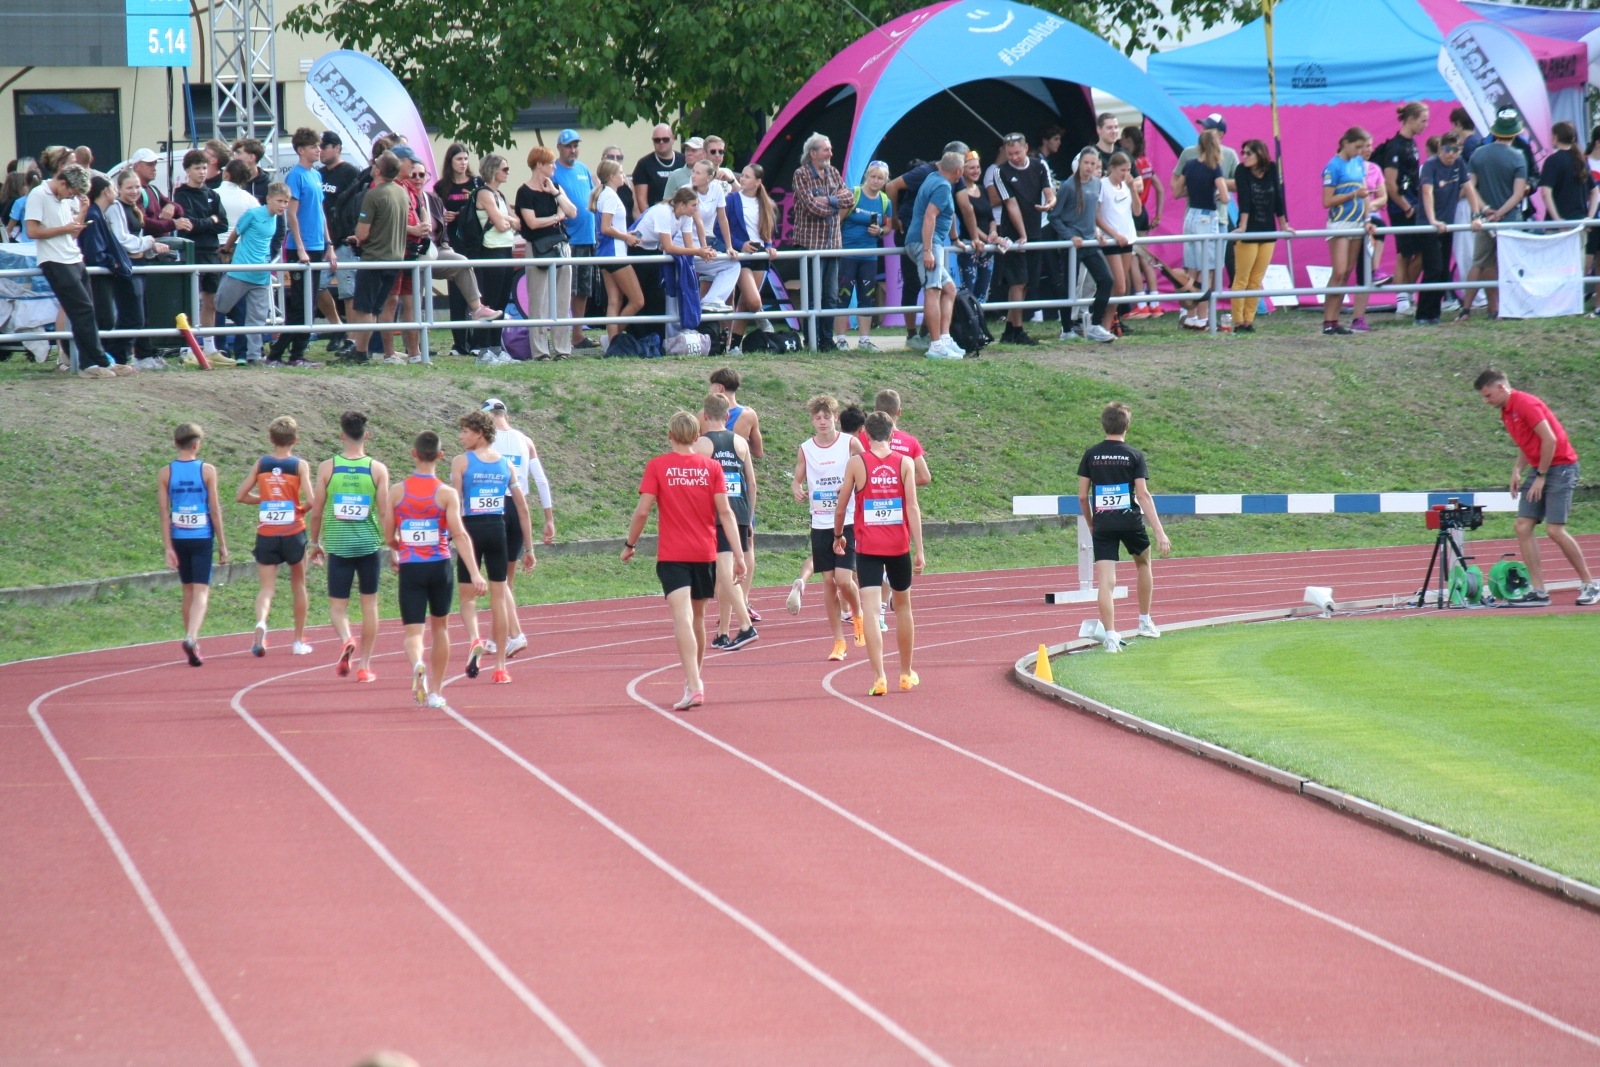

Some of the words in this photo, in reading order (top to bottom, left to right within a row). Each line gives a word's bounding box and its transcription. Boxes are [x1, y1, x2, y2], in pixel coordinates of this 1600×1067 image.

[148, 27, 187, 54] 5.14
[665, 467, 710, 478] ATLETIKA
[667, 476, 709, 486] LITOMYŠL
[478, 497, 500, 508] 586
[822, 500, 838, 508] 525
[1102, 495, 1123, 506] 537
[265, 511, 287, 521] 427
[340, 505, 362, 516] 452
[874, 509, 892, 518] 497
[178, 514, 198, 524] 418
[412, 530, 426, 542] 61
